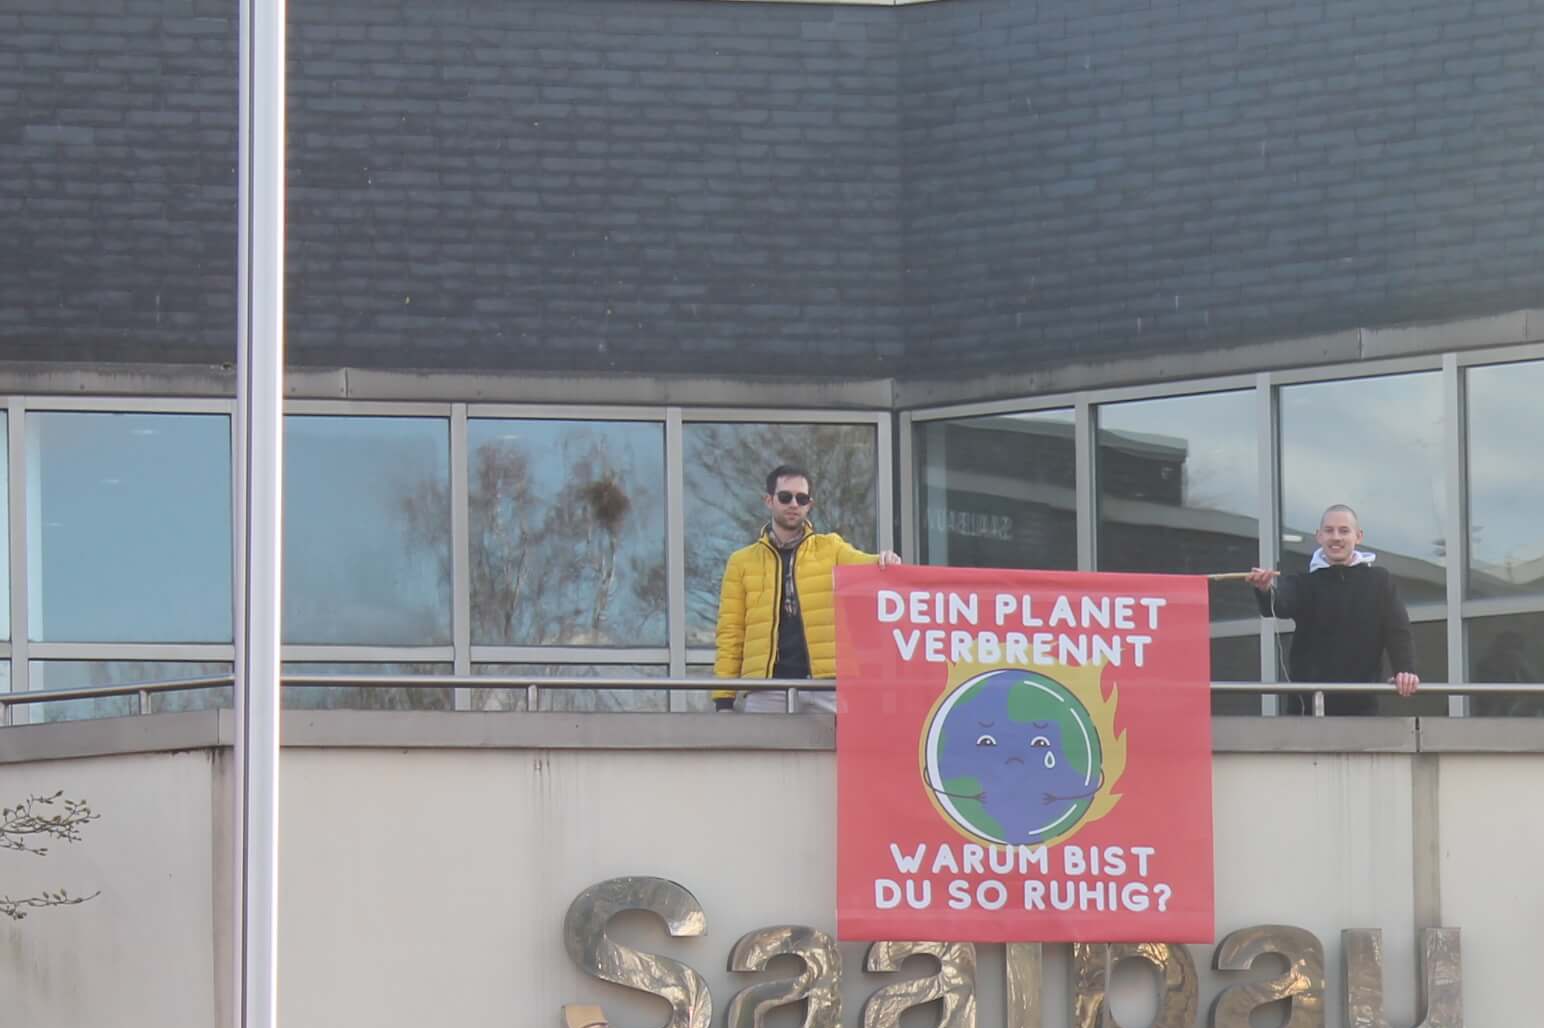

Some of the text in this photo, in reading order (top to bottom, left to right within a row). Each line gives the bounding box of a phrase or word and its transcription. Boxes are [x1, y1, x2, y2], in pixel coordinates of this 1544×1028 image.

[877, 590, 1167, 630] DEIN PLANET
[893, 630, 1152, 666] VERBRENNT
[890, 843, 1155, 876] WARUM BIST
[875, 879, 1172, 912] DU SO RUHIG?
